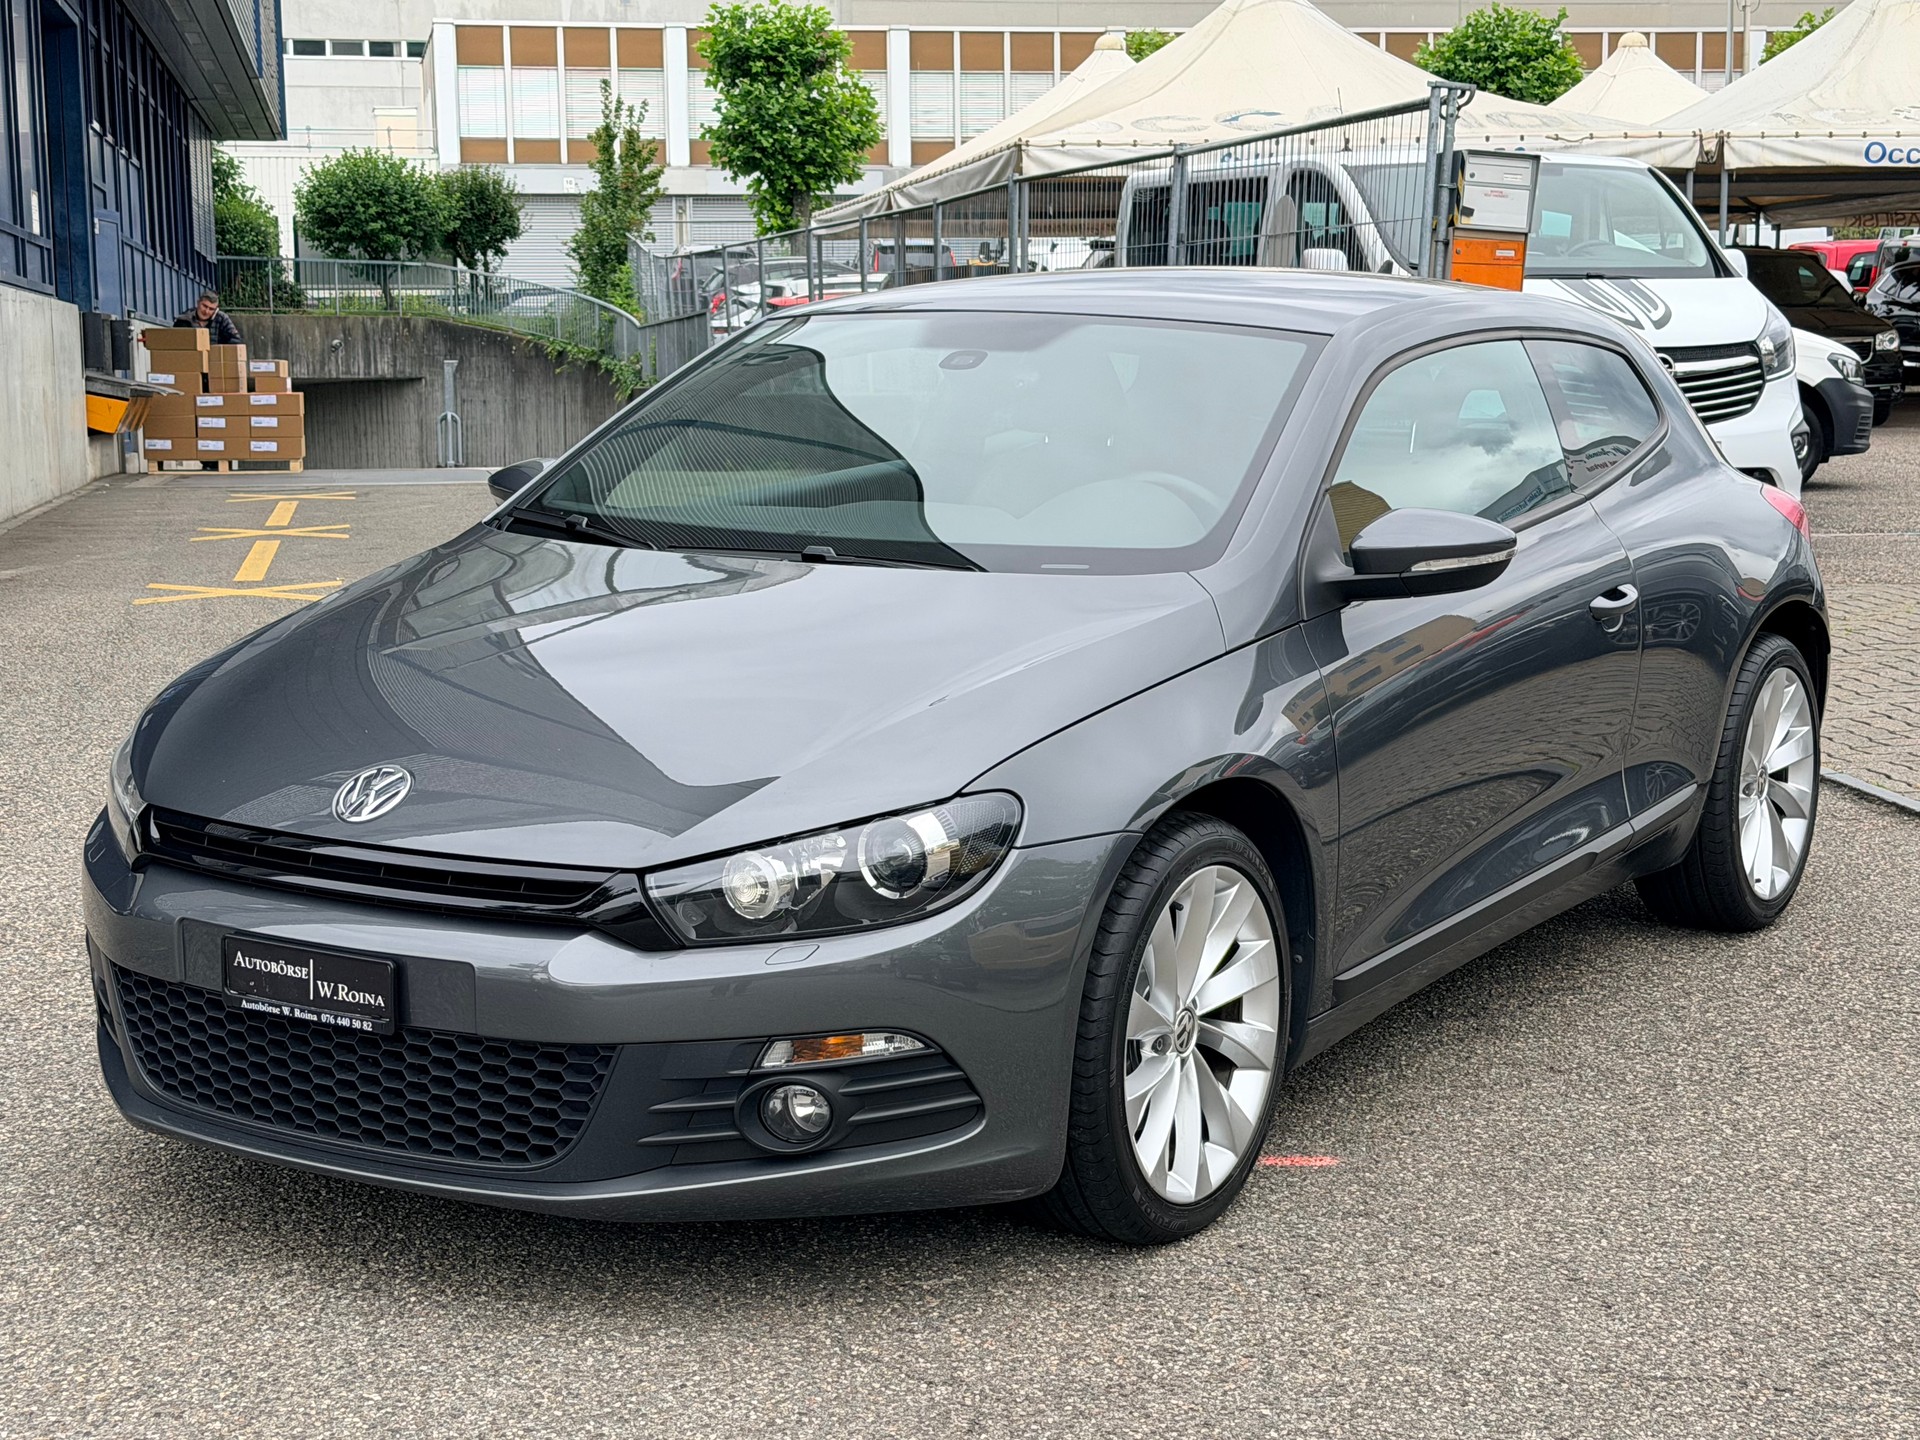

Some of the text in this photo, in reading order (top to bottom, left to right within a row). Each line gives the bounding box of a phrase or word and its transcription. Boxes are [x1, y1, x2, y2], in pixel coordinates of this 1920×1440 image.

[240, 999, 373, 1031] Autobörse W. Roina 076 440 50 82
